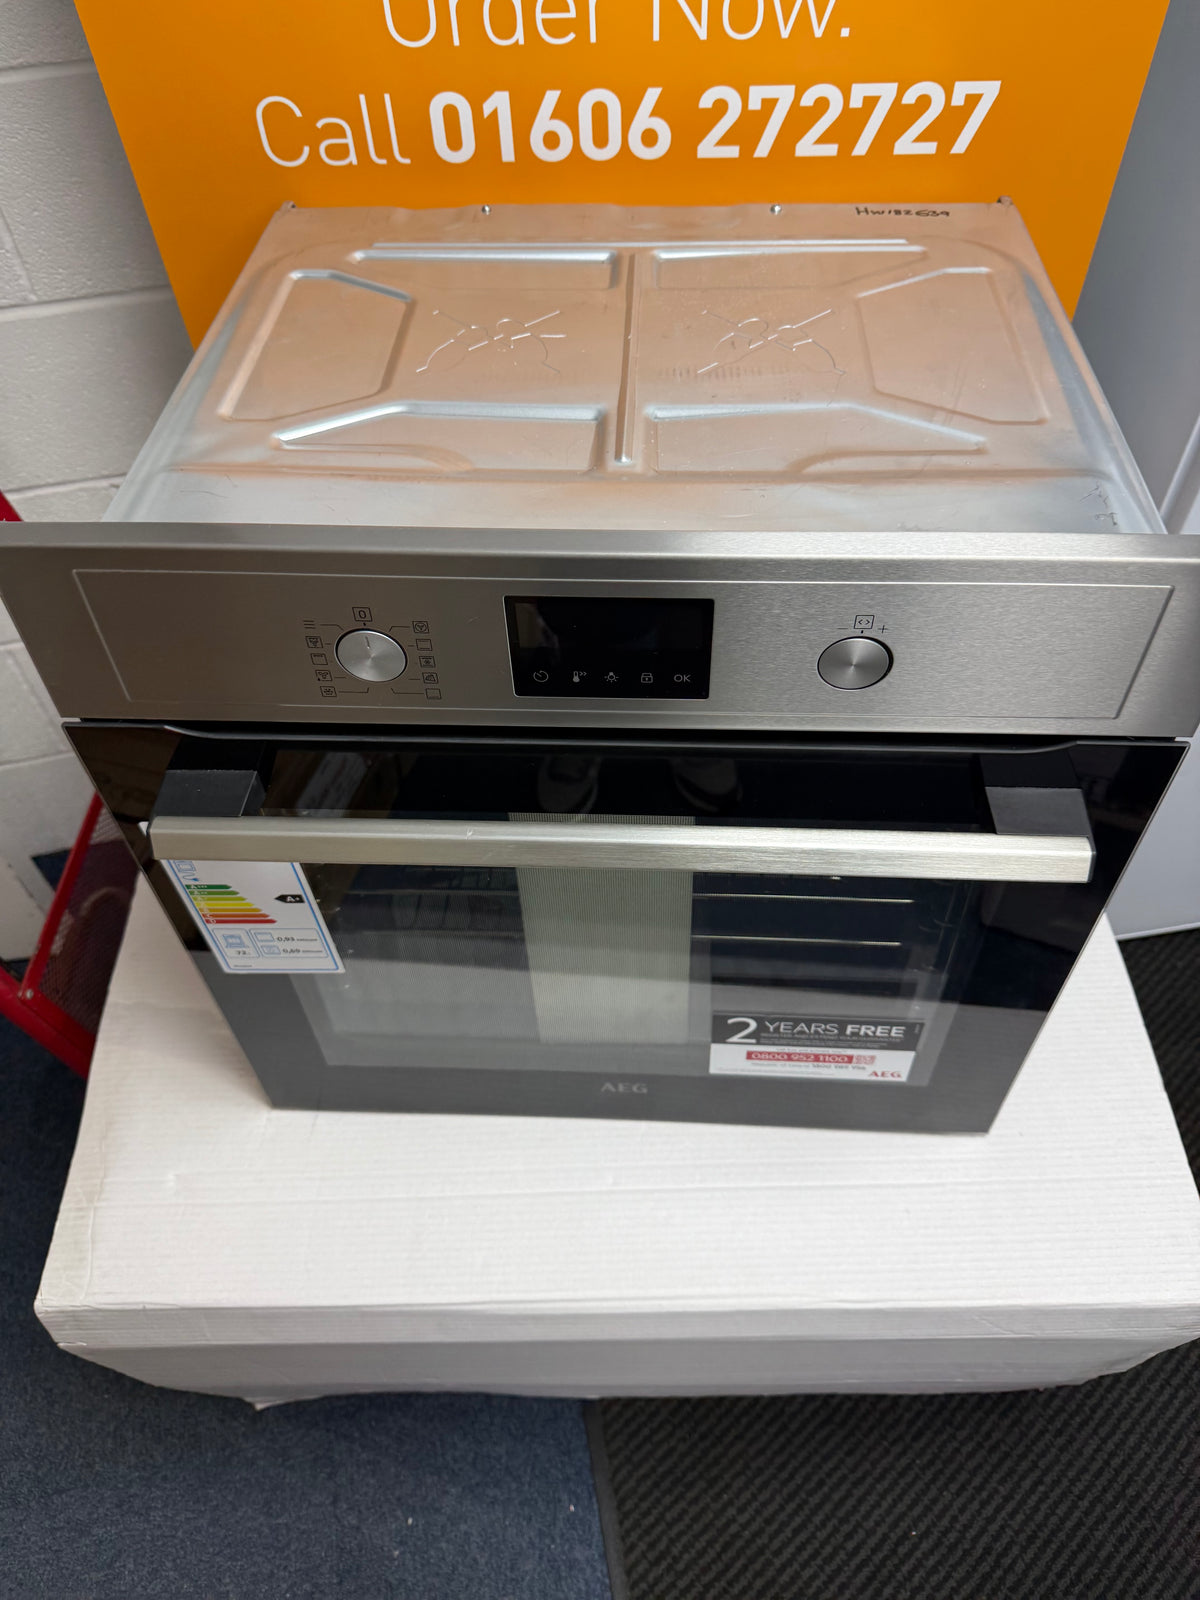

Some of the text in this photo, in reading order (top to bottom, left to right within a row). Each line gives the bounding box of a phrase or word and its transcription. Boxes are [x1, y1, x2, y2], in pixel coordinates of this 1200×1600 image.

[254, 80, 1003, 168] Call 01606 272727
[673, 673, 691, 683] OK
[725, 1016, 758, 1044] 2
[764, 1020, 839, 1035] YEARS
[845, 1024, 906, 1038] FREE
[751, 1052, 788, 1060] 0800
[818, 1055, 848, 1063] 1100
[868, 1070, 902, 1078] AEG
[600, 1082, 648, 1094] AEG
